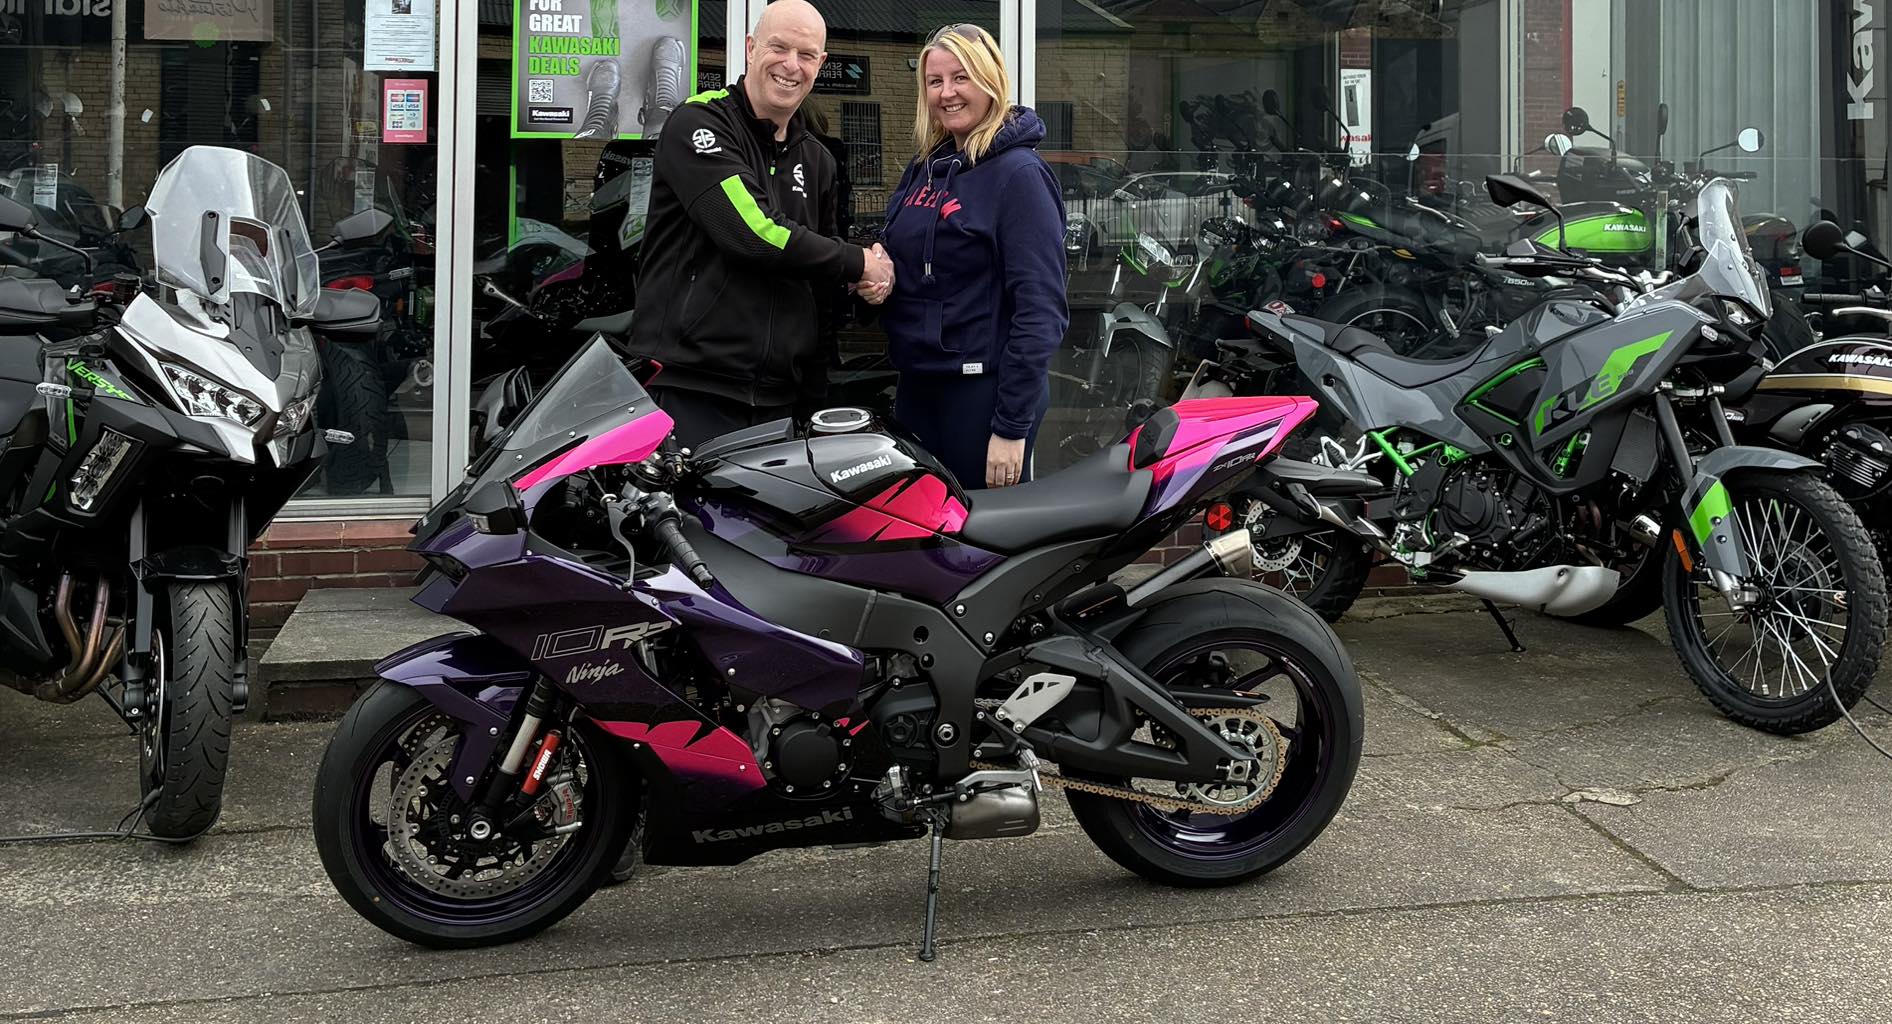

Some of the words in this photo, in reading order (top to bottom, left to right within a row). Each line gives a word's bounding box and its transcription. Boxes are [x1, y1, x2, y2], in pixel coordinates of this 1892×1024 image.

[529, 14, 582, 33] GREAT
[528, 36, 620, 56] KAWASAKI
[528, 56, 581, 75] DEALS
[532, 109, 570, 117] Kawasaki
[1604, 223, 1647, 233] KAWASAKI
[830, 455, 892, 483] Kawasaki
[565, 659, 625, 685] Ninja
[533, 749, 552, 781] SHOWA
[692, 806, 853, 844] Kawasaki
